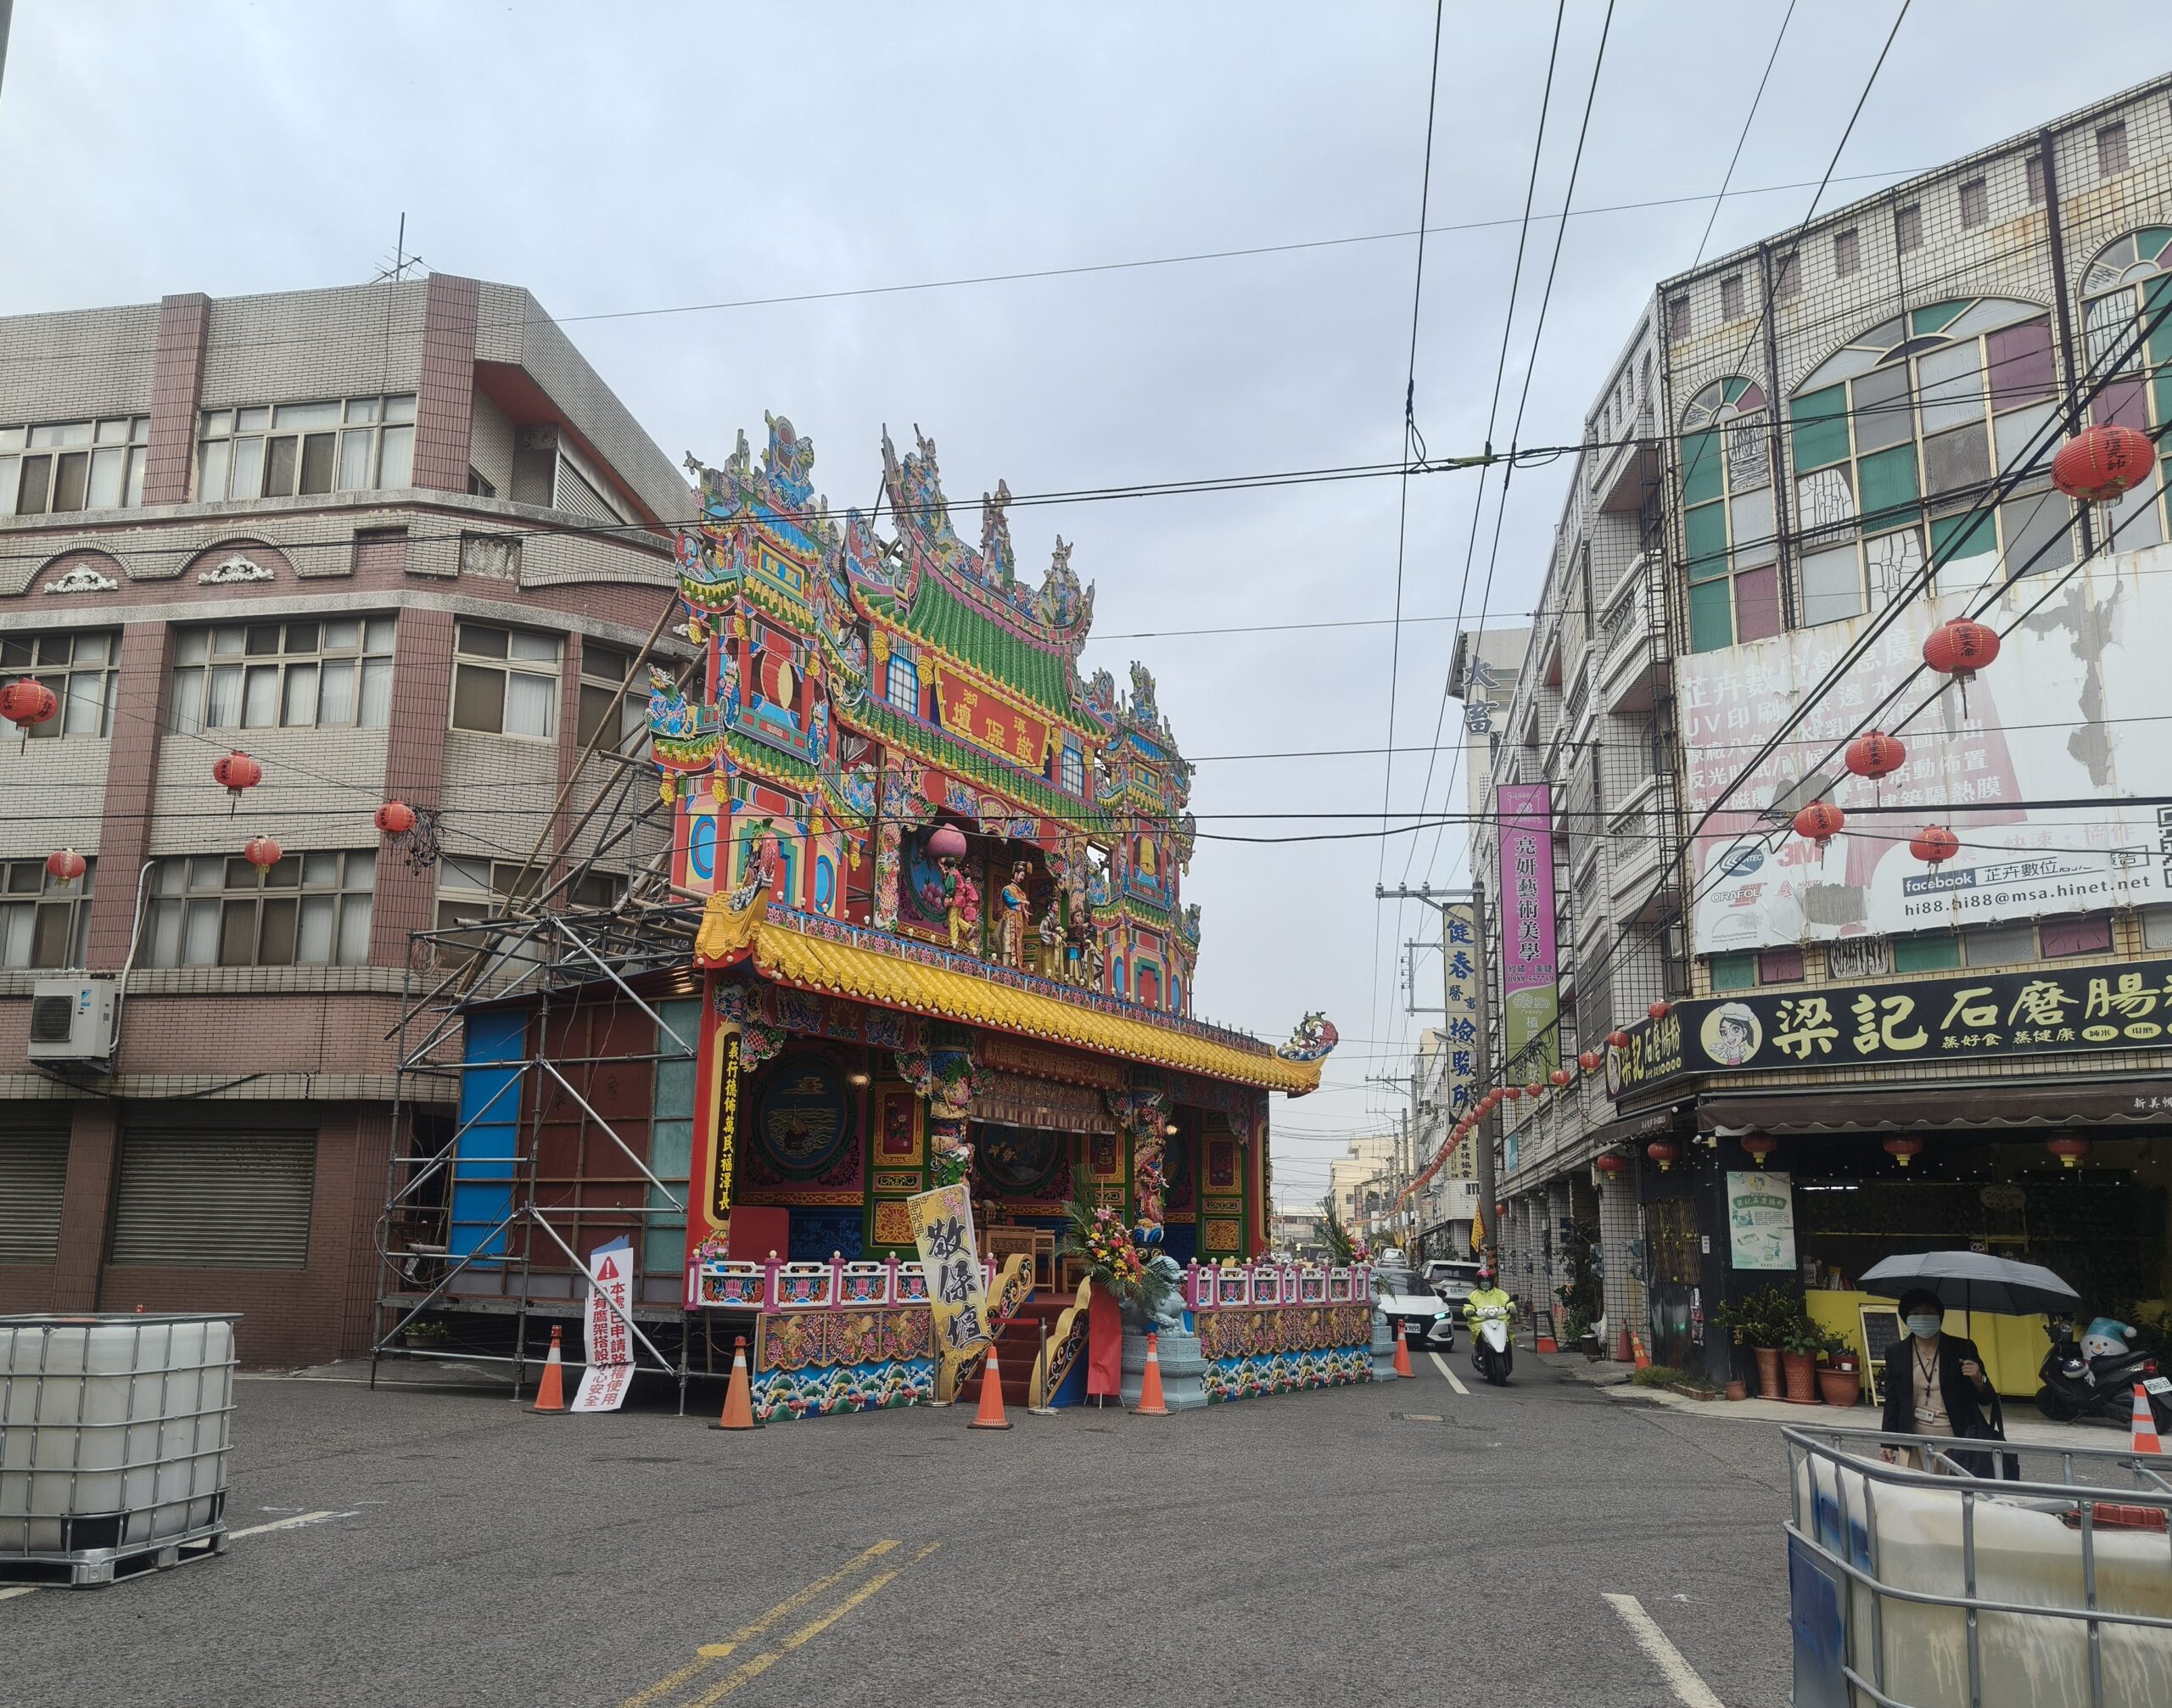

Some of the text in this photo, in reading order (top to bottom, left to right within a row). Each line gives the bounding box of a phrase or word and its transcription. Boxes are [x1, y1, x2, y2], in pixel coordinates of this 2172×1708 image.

[1777, 839, 1822, 867] 3M
[1710, 888, 1762, 903] ORAFOL
[1906, 874, 1973, 891] facebook
[1514, 836, 1541, 962] 亮妍藝術美學
[1772, 972, 2172, 1059] 梁記石磨腸
[1941, 1028, 2076, 1050] 蒸好食 蒸健康
[925, 1215, 993, 1351] 敬保壇
